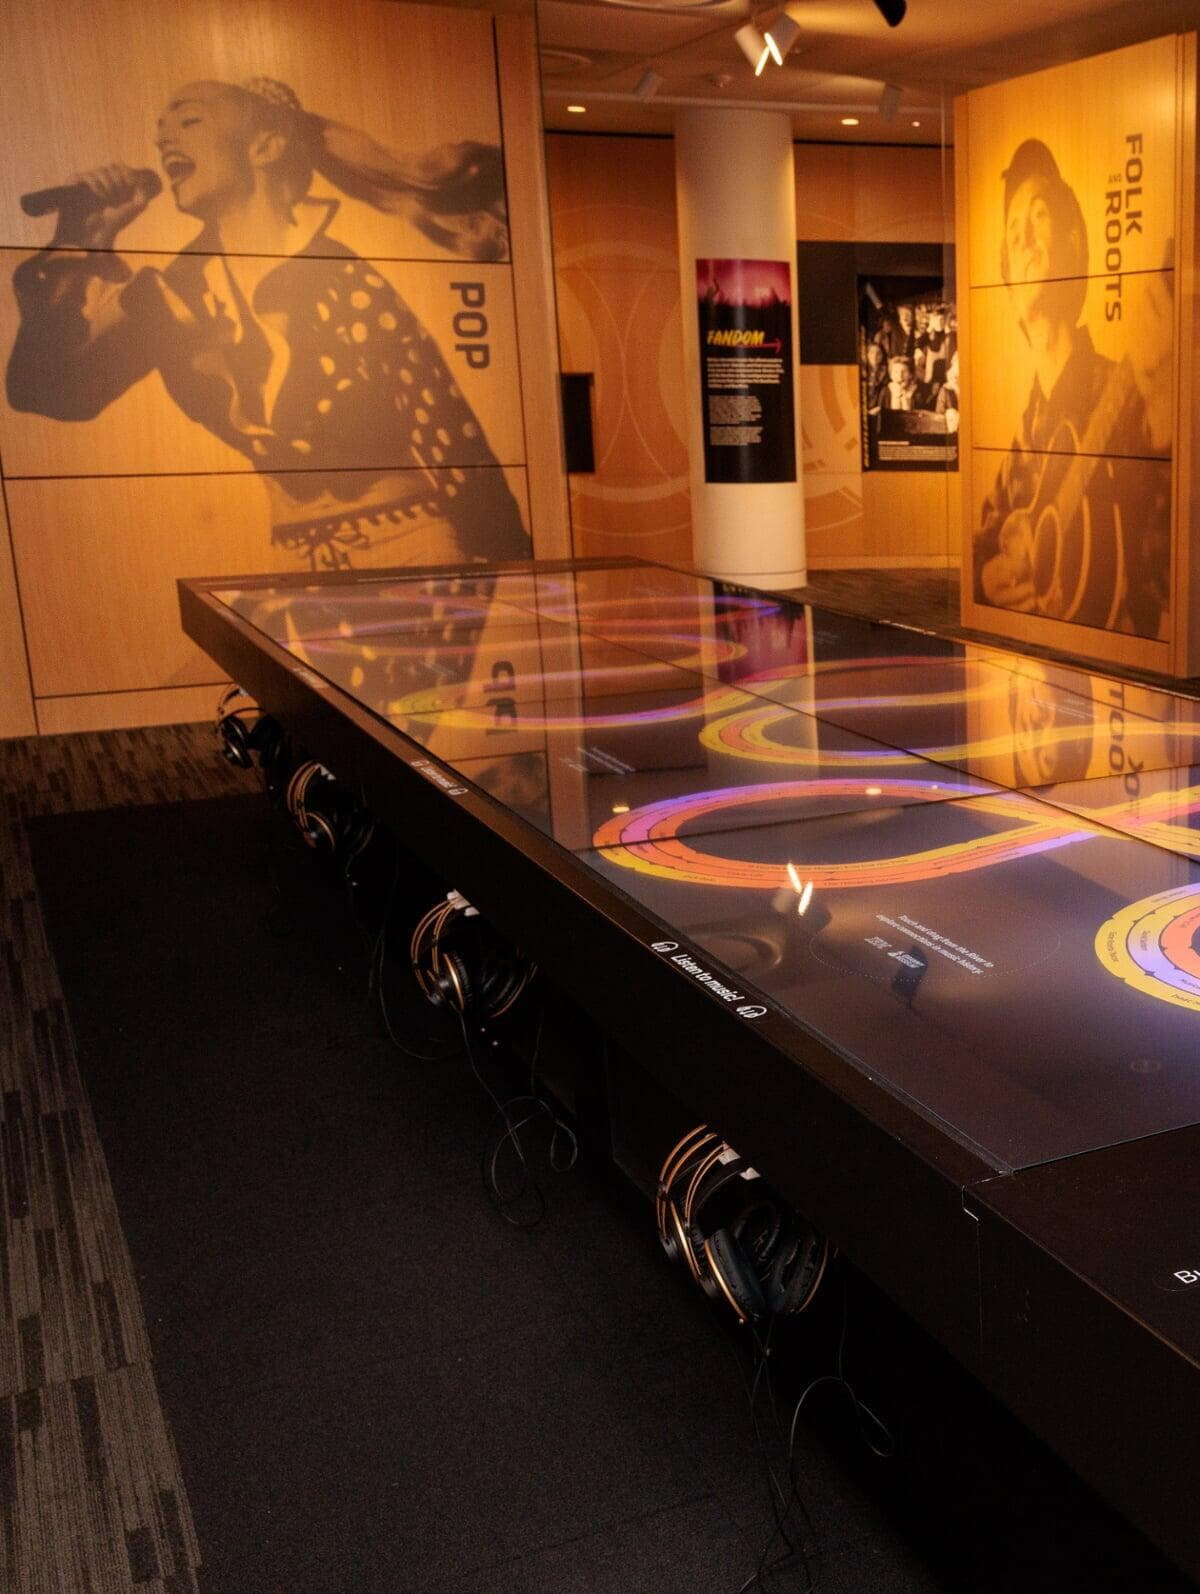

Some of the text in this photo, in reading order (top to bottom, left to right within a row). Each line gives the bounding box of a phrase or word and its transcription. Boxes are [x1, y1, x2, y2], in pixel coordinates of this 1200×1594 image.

[1125, 132, 1144, 236] FOLK
[1105, 189, 1122, 322] ROOTS
[448, 280, 491, 373] POP
[706, 329, 765, 347] FANDOM
[670, 953, 745, 1002] Listen to music!
